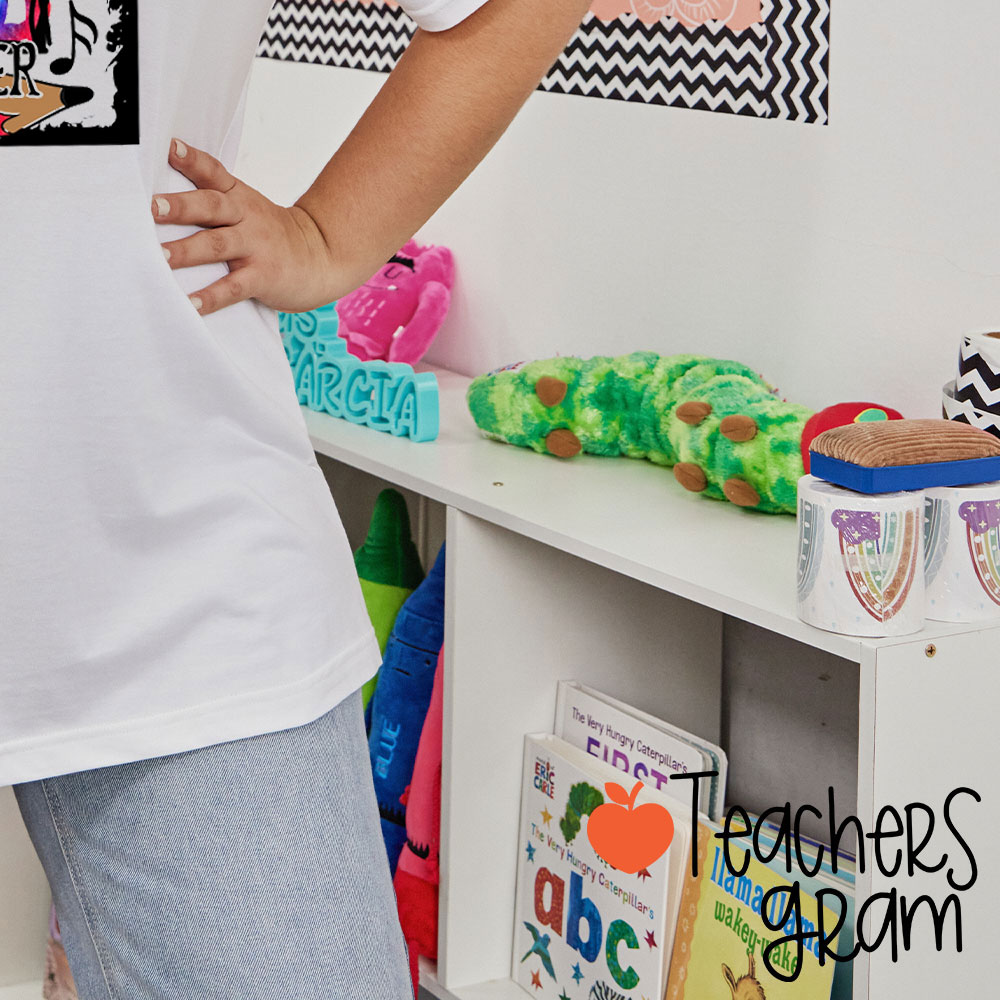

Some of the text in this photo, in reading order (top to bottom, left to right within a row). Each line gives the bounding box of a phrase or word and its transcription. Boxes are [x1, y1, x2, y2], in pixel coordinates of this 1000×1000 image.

[290, 347, 418, 436] ARCIA
[375, 715, 401, 779] BLUE
[535, 760, 555, 786] ERIC
[572, 706, 688, 774] The Very Hungry Caterpillar's
[534, 776, 554, 800] CARLE
[531, 822, 654, 920] The Very Hungry Caterpillar's
[534, 867, 640, 991] abc
